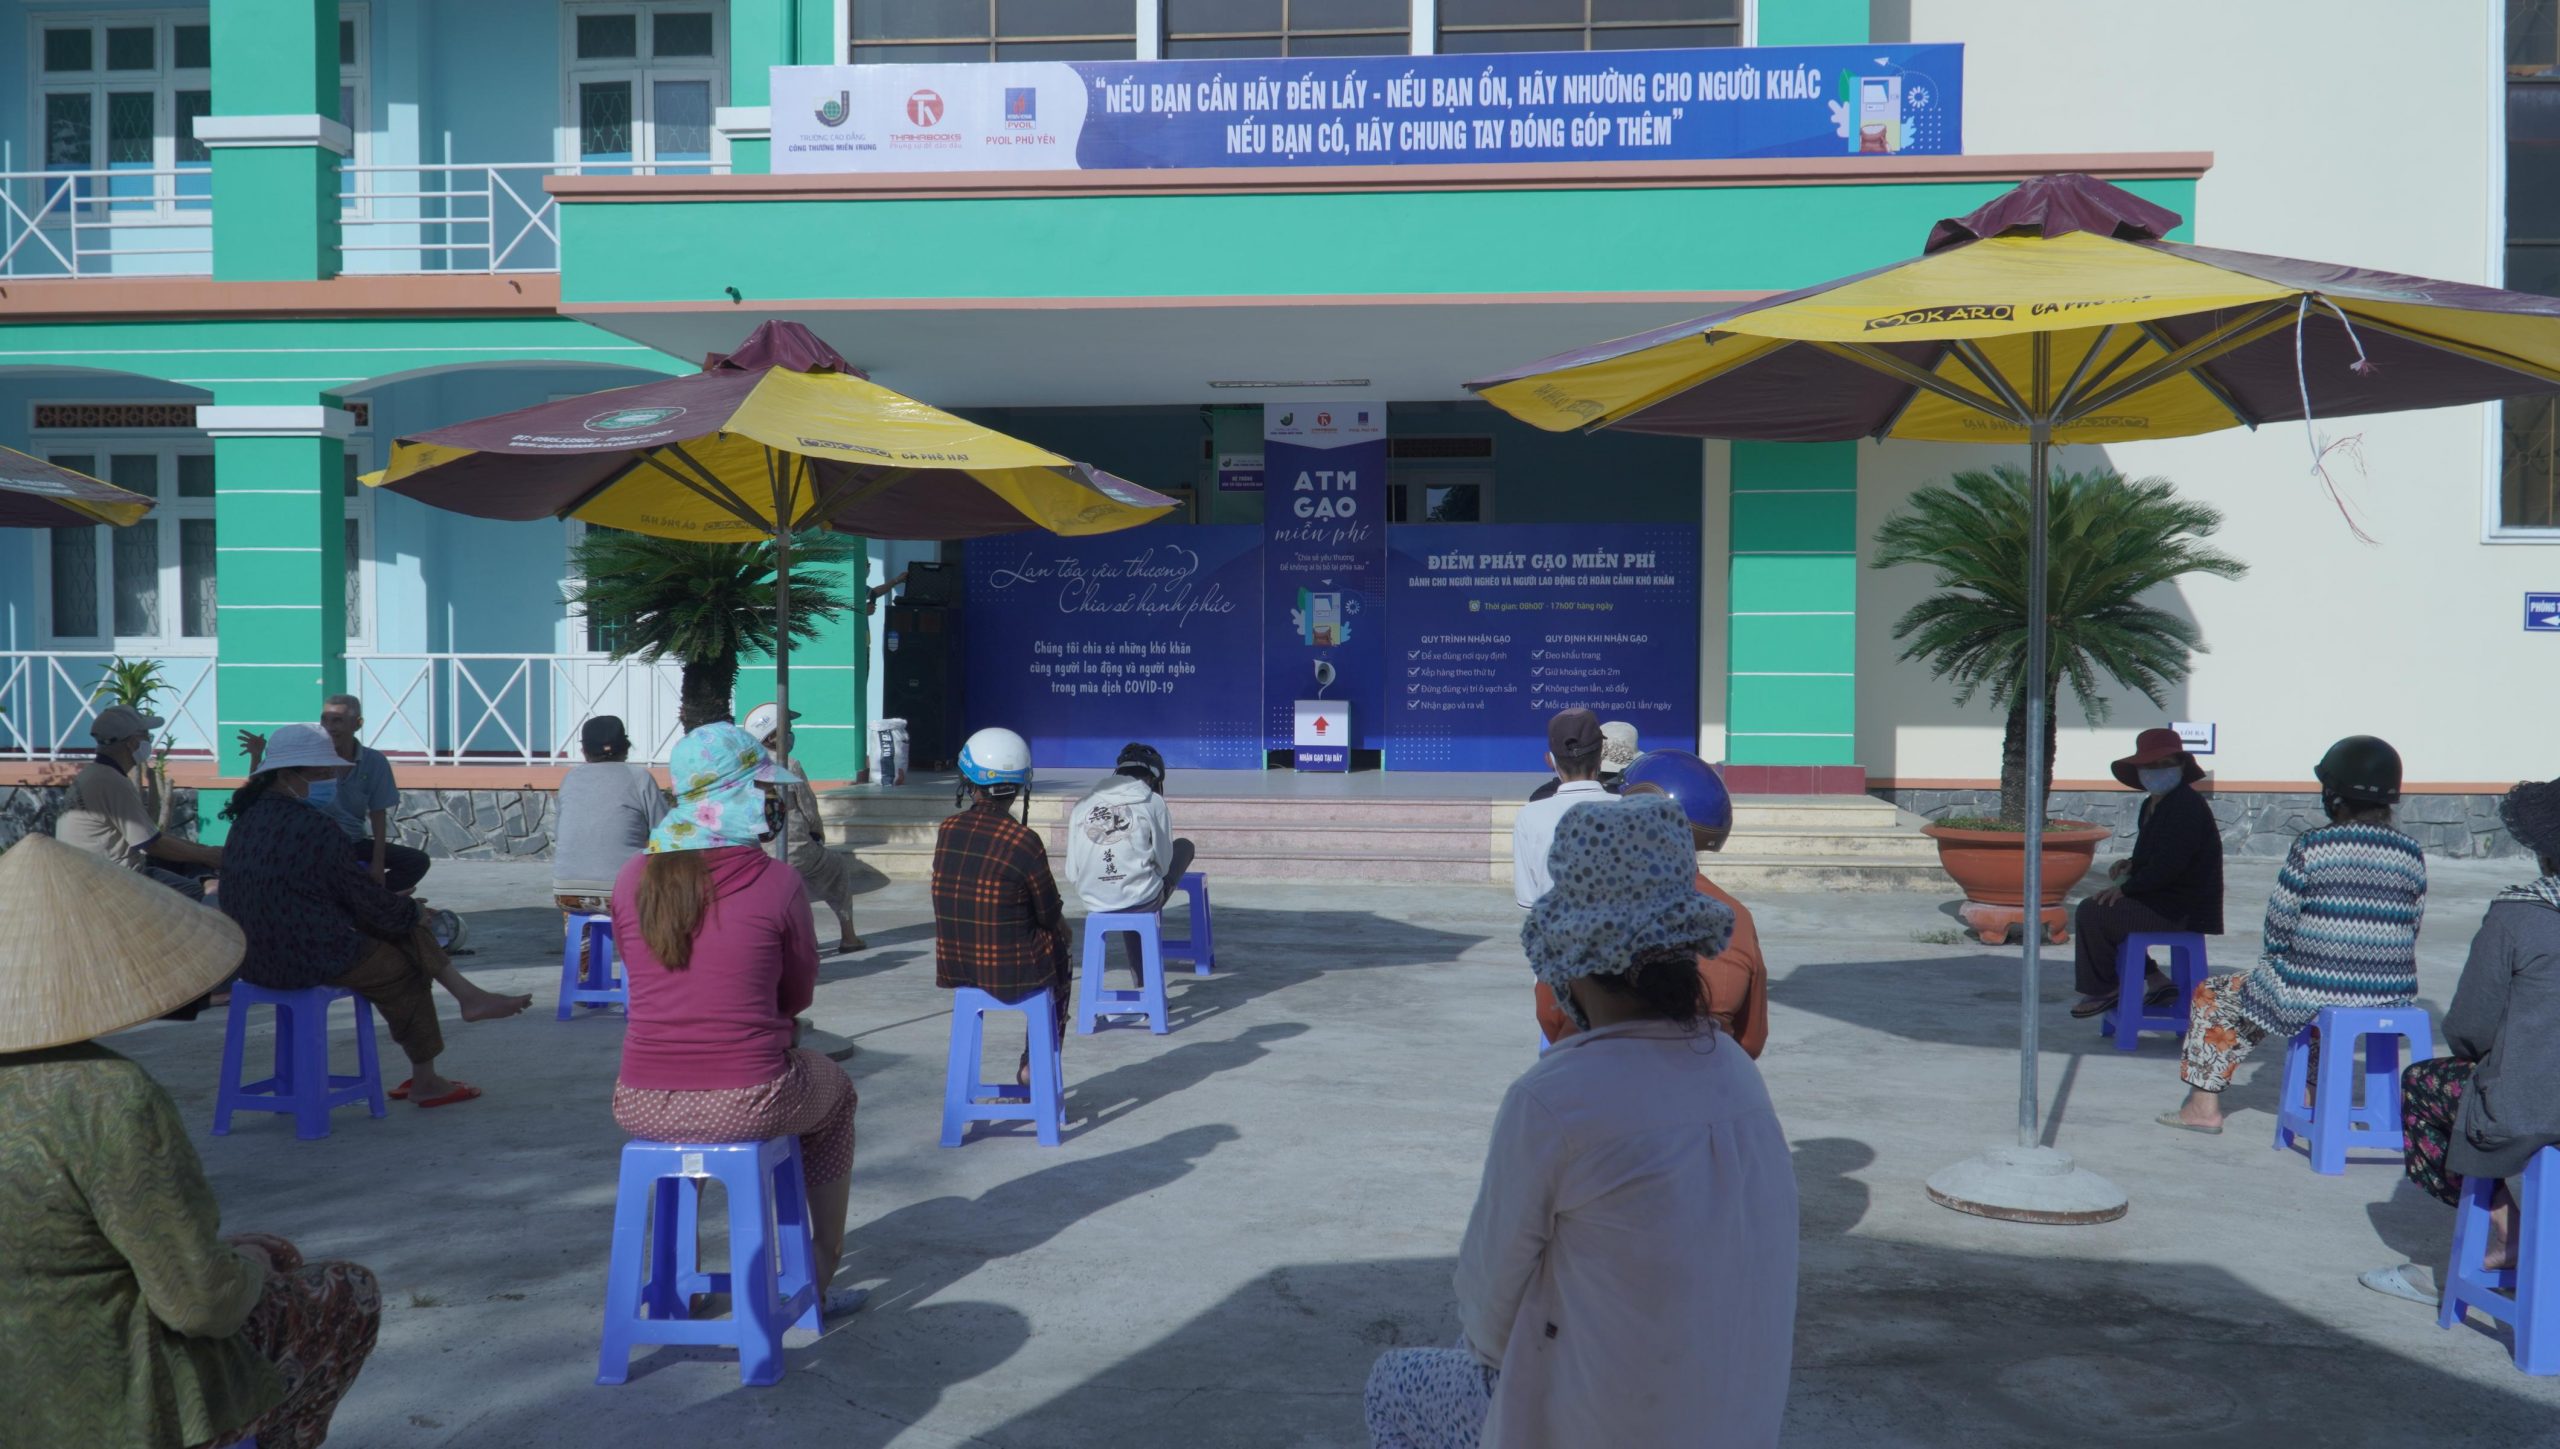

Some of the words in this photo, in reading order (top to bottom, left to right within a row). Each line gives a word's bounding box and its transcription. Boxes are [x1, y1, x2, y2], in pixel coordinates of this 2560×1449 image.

[1095, 74, 1145, 113] “NẾU
[1152, 84, 1191, 119] BẠN
[1197, 73, 1238, 112] CẦN
[1248, 76, 1281, 111] HÃY
[1287, 71, 1326, 110] ĐẾN
[1332, 70, 1368, 109] LẤY
[1386, 69, 1427, 108] NẾU
[1432, 78, 1473, 114] BẠN
[1479, 66, 1514, 110] ỔN,
[1518, 68, 1556, 106] HÃY
[1563, 67, 1648, 104] NHƯỜNG
[1652, 71, 1692, 103] CHO
[1698, 66, 1762, 102] NGƯỜI
[1766, 62, 1822, 101] KHÁC
[986, 136, 1012, 144] PVOIL
[1016, 134, 1034, 144] PHÚ
[1038, 132, 1056, 144] YÊN
[1226, 115, 1266, 154] NẾU
[1272, 123, 1312, 160] BẠN
[1318, 117, 1350, 156] CÓ,
[1356, 116, 1394, 152] HÃY
[1400, 120, 1468, 151] CHUNG
[1472, 119, 1505, 149] TAY
[1510, 112, 1565, 149] ĐÓNG
[1570, 111, 1610, 148] GÓP
[1616, 108, 1684, 147] THÊM”
[1870, 305, 2011, 330] MOKARO
[1293, 470, 1357, 491] ATM
[1293, 496, 1357, 522] GẠO
[1274, 521, 1330, 542] miễn
[1332, 520, 1371, 546] phí
[1428, 550, 1474, 570] ĐIỂM
[1479, 551, 1526, 570] PHÁT
[1532, 553, 1568, 572] GẠO
[1572, 547, 1620, 570] MIỄN
[1624, 550, 1656, 569] PHÍ
[990, 552, 1054, 589] Lan
[1055, 557, 1088, 580] tỏa
[1090, 562, 1121, 594] yêu
[1124, 546, 1198, 592] thương
[1408, 576, 1430, 587] DÀNH
[1432, 577, 1447, 586] CHO
[1449, 576, 1472, 586] NGƯỜI
[1474, 576, 1500, 586] NGHÈO
[1502, 576, 1512, 586] VÀ
[1514, 575, 1536, 586] NGƯỜI
[1538, 576, 1552, 586] LAO
[1554, 576, 1576, 587] ĐỘNG
[1577, 574, 1588, 586] CÓ
[1590, 574, 1611, 586] HOÀN
[1613, 574, 1634, 586] CẢNH
[1636, 574, 1651, 586] KHÓ
[1653, 574, 1674, 586] KHĂN
[1059, 577, 1112, 614] Chia
[1113, 593, 1136, 613] sẻ
[1137, 583, 1190, 617] hạnh
[1180, 582, 1236, 628] phúc
[1502, 602, 1518, 612] gian:
[1576, 602, 1594, 612] hàng
[1596, 602, 1614, 612] ngày
[1421, 635, 1439, 644] QUY
[1440, 633, 1466, 644] TRÌNH
[1468, 633, 1492, 645] NHẬN
[1493, 634, 1511, 645] GẠO
[1545, 634, 1563, 644] QUY
[1564, 634, 1586, 644] ĐỊNH
[1588, 634, 1602, 643] KHI
[1605, 633, 1628, 644] NHẬN
[1630, 634, 1648, 644] GẠO
[1034, 640, 1062, 658] Chúng
[1066, 642, 1080, 654] tôi
[1082, 642, 1102, 654] chia
[1119, 642, 1146, 658] những
[1150, 641, 1166, 654] khó
[1170, 641, 1191, 654] khăn
[1545, 651, 1560, 660] Đeo
[1562, 649, 1580, 660] khẩu
[1581, 652, 1601, 661] trang
[1030, 662, 1051, 677] cùng
[1054, 662, 1080, 676] người
[1084, 662, 1098, 674] lao
[1100, 661, 1122, 678] động
[1126, 662, 1136, 674] và
[1140, 662, 1165, 676] người
[1168, 662, 1196, 676] nghèo
[1560, 667, 1587, 678] khoảng
[1588, 668, 1606, 676] cách
[1608, 668, 1620, 676] 2m
[1051, 682, 1076, 696] trong
[1080, 682, 1098, 694] mùa
[1102, 681, 1121, 696] dịch
[1124, 681, 1174, 694] COVID-19
[1299, 752, 1313, 763] NHẬN
[1314, 753, 1324, 764] GẠO
[1324, 753, 1332, 764] TẠI
[1333, 752, 1343, 762] ĐÂY
